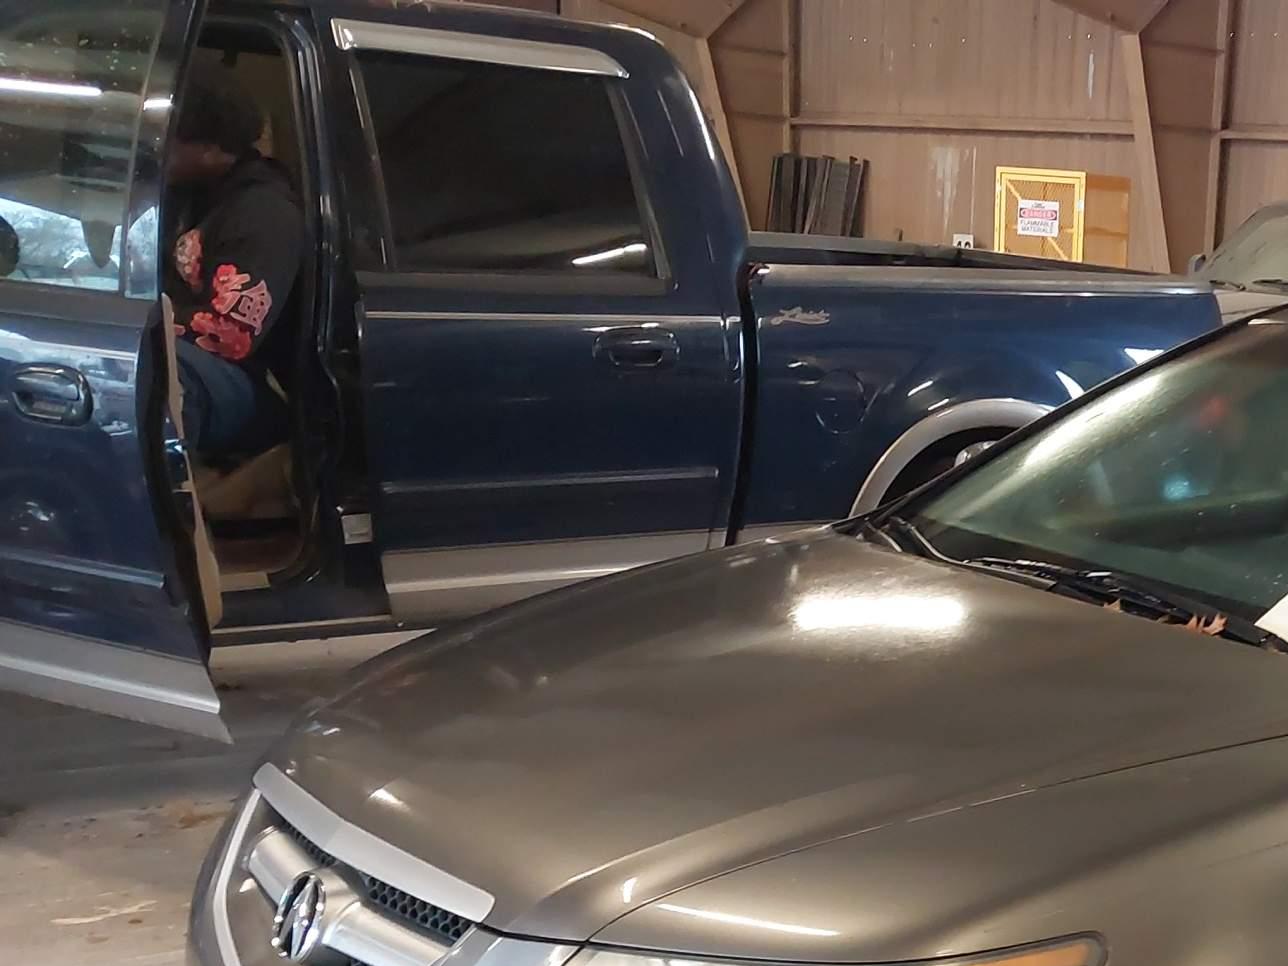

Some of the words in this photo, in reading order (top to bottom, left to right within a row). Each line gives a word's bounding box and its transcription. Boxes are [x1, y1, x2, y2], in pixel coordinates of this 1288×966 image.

[1025, 209, 1052, 219] DANGER
[1020, 219, 1055, 228] FLAMMABLE
[1021, 226, 1054, 234] MATERIALS
